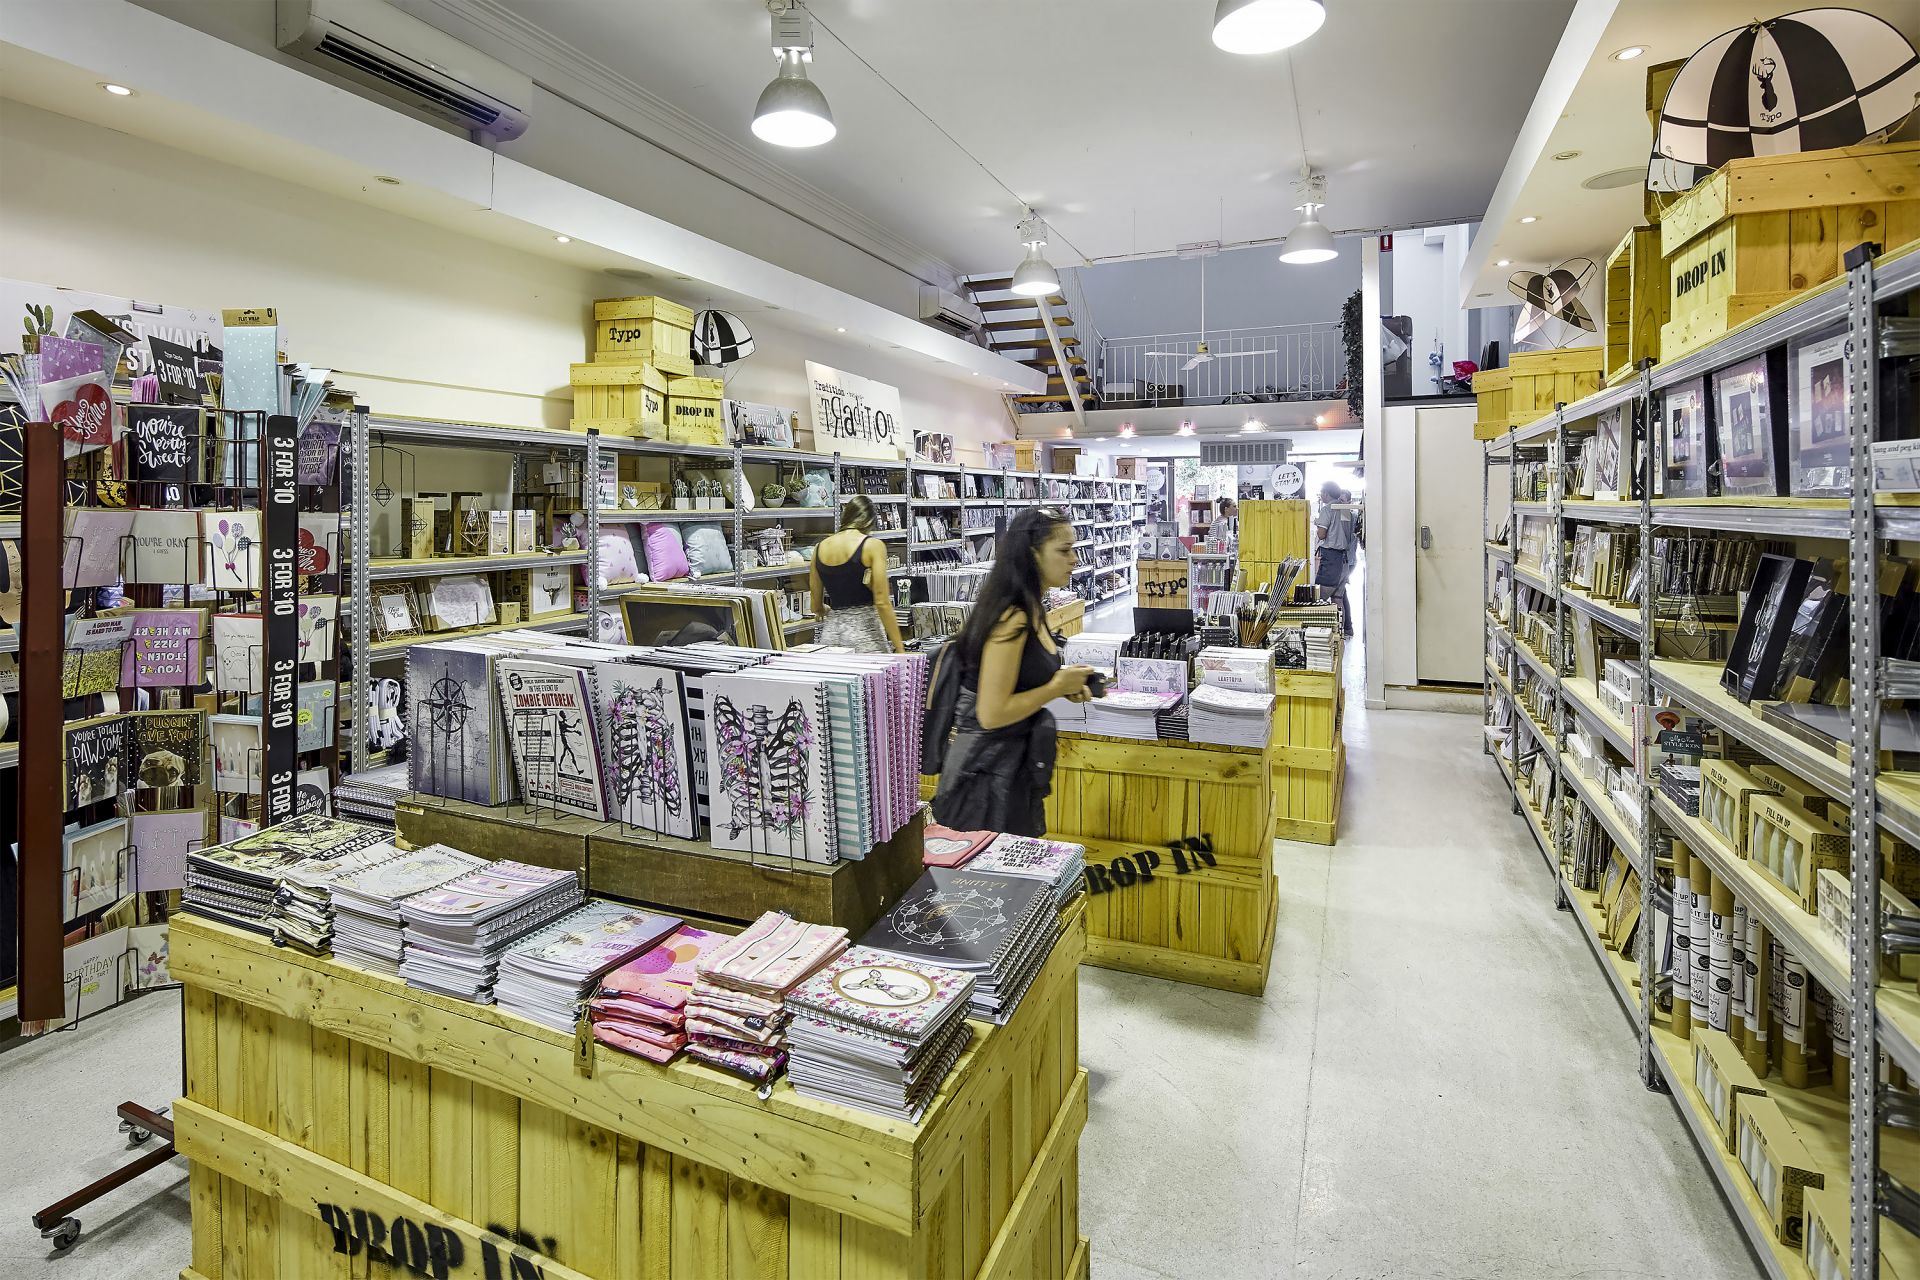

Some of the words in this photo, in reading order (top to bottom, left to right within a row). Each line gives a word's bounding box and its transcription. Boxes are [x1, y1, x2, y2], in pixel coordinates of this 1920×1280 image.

[1760, 112, 1782, 123] Typo
[1676, 260, 1708, 298] DROP
[1712, 248, 1726, 278] IN
[609, 327, 641, 343] Typo
[158, 360, 167, 384] 3
[167, 364, 184, 386] FOR
[183, 368, 197, 390] $10
[814, 380, 845, 396] Tradition
[645, 394, 659, 413] Typo
[675, 405, 700, 417] DROP
[701, 406, 715, 418] IN
[274, 436, 295, 448] 3
[276, 451, 294, 478] FOR
[1278, 472, 1296, 480] LET'S
[274, 480, 295, 504] $10
[166, 538, 188, 548] OKAY
[272, 548, 294, 559] 3
[274, 562, 293, 590] FOR
[1144, 578, 1188, 598] Typo
[273, 591, 295, 616] $10
[174, 627, 191, 636] MY
[274, 659, 294, 672] 3
[273, 675, 292, 702] FOR
[514, 693, 541, 707] ZOMBIE
[542, 693, 576, 707] OUTBREAK
[272, 702, 293, 728] $10
[72, 730, 96, 745] YOU'RE
[97, 721, 124, 738] TOTALLY
[271, 771, 292, 785] 3
[1723, 777, 1728, 786] UP
[1764, 775, 1773, 786] FILL
[1779, 785, 1786, 794] UP
[272, 785, 291, 816] FOR
[1766, 807, 1776, 819] FILL
[1784, 820, 1791, 828] UP
[1084, 850, 1160, 896] ROP
[1166, 832, 1218, 875] IN
[66, 956, 115, 982] BIRTHDAY
[83, 956, 99, 966] HAPPY
[1762, 1136, 1767, 1146] UP
[1833, 1242, 1840, 1257] UP
